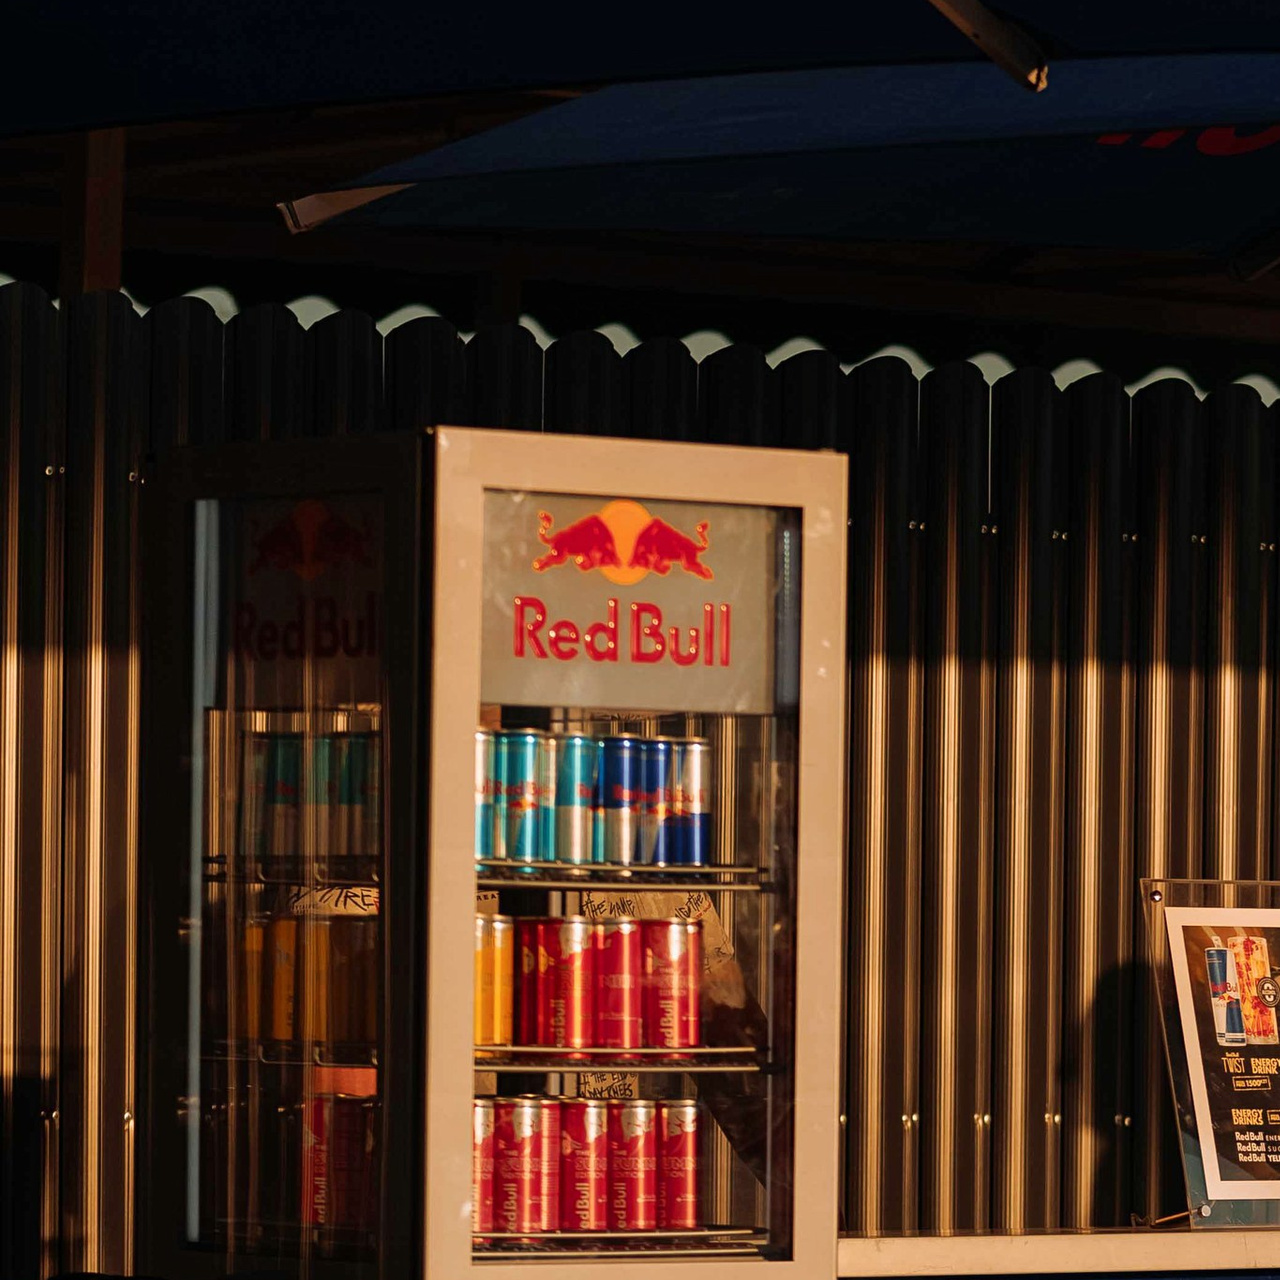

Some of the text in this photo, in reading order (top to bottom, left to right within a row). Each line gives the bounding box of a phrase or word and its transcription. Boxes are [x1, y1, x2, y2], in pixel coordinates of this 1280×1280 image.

[514, 596, 731, 667] Red Bull
[1221, 1058, 1245, 1073] TWIST
[1252, 1065, 1279, 1074] DRINK
[1231, 1109, 1263, 1118] ENERGY
[1233, 1116, 1264, 1125] DRINKS
[1235, 1132, 1249, 1141] Red
[1249, 1132, 1264, 1141] Bull
[1237, 1142, 1250, 1152] Red
[1251, 1142, 1266, 1152] Bull
[1238, 1153, 1252, 1162] Red
[1252, 1153, 1266, 1162] Bull
[575, 1182, 590, 1230] ed Bull
[613, 1182, 627, 1229] ed Bull
